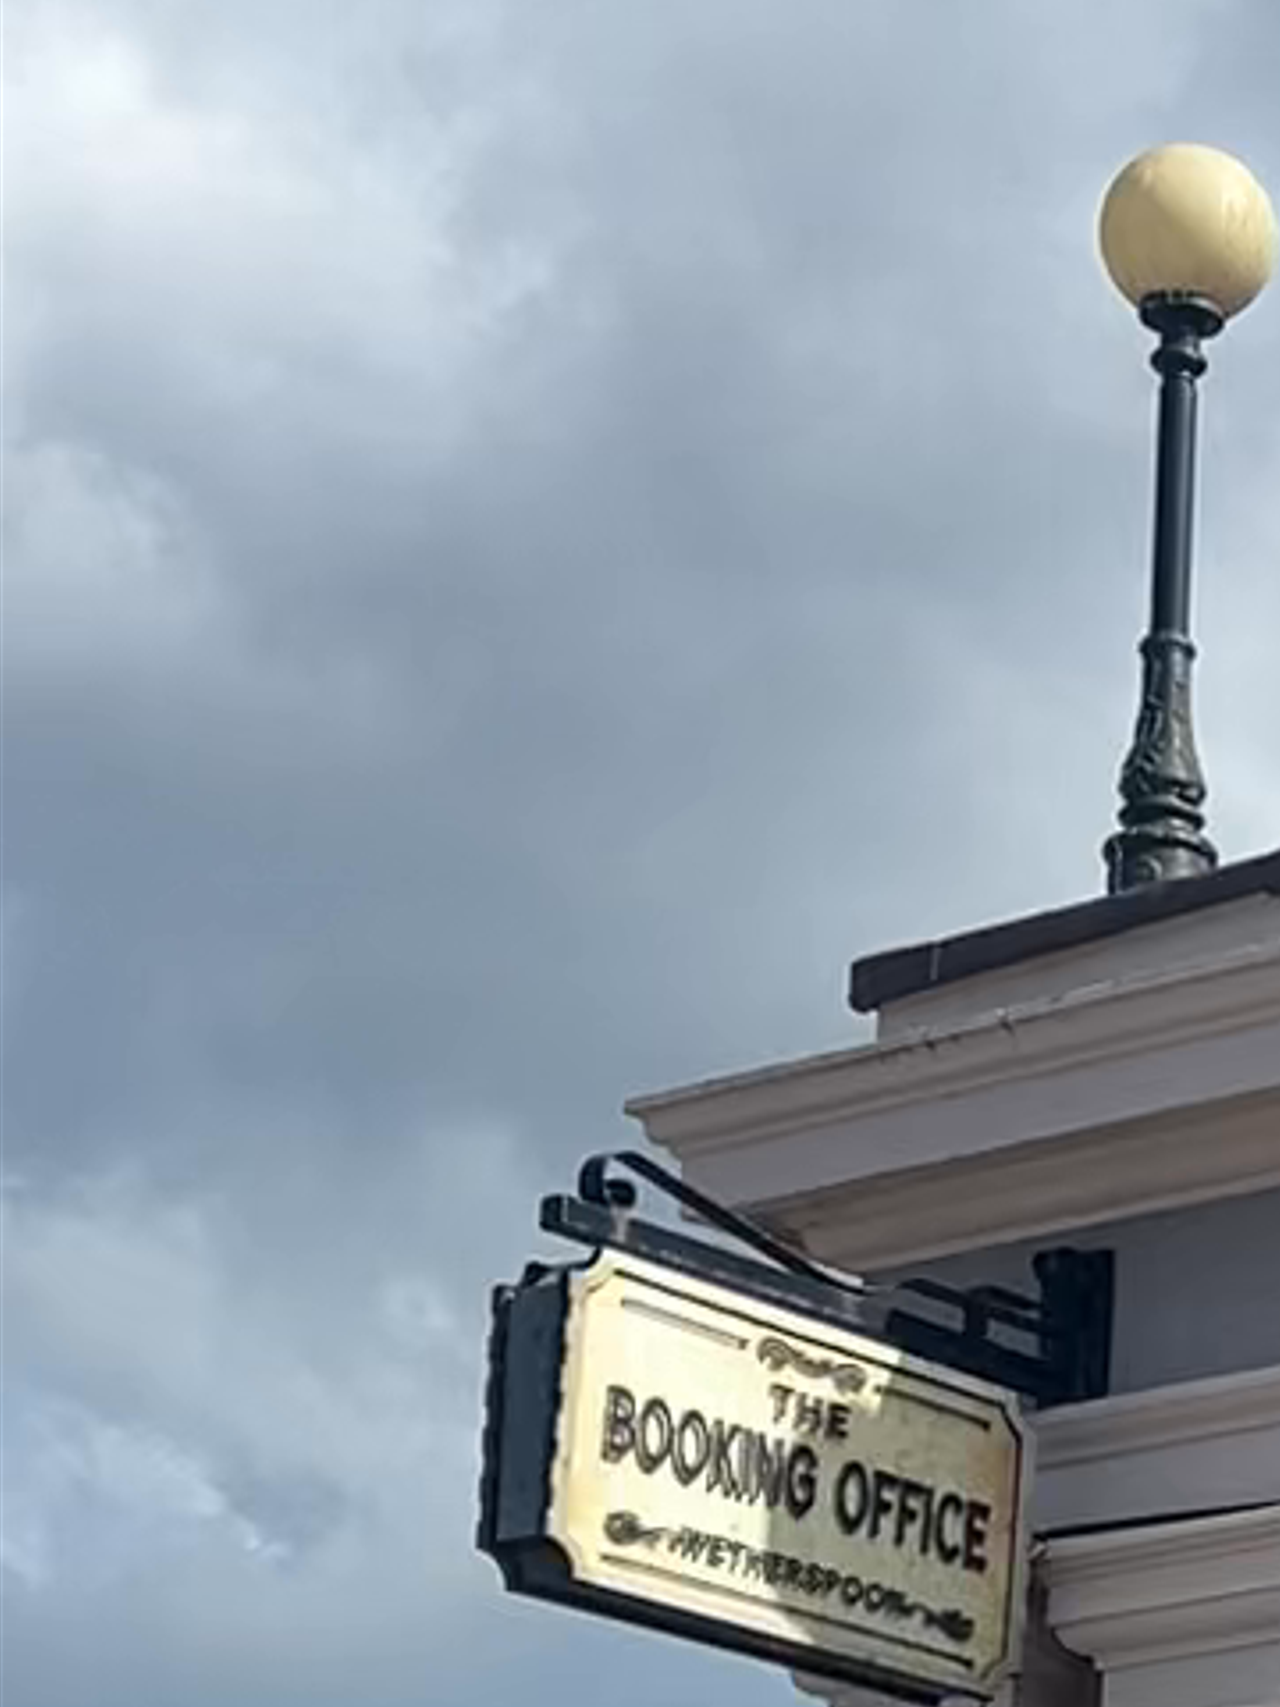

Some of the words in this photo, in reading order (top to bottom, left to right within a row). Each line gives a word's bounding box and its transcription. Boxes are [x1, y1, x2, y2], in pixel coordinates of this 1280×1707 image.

[769, 1382, 850, 1439] THE
[601, 1383, 818, 1521] BOOKING
[834, 1459, 992, 1574] OFFICE
[670, 1525, 908, 1618] WETHERSPOON
